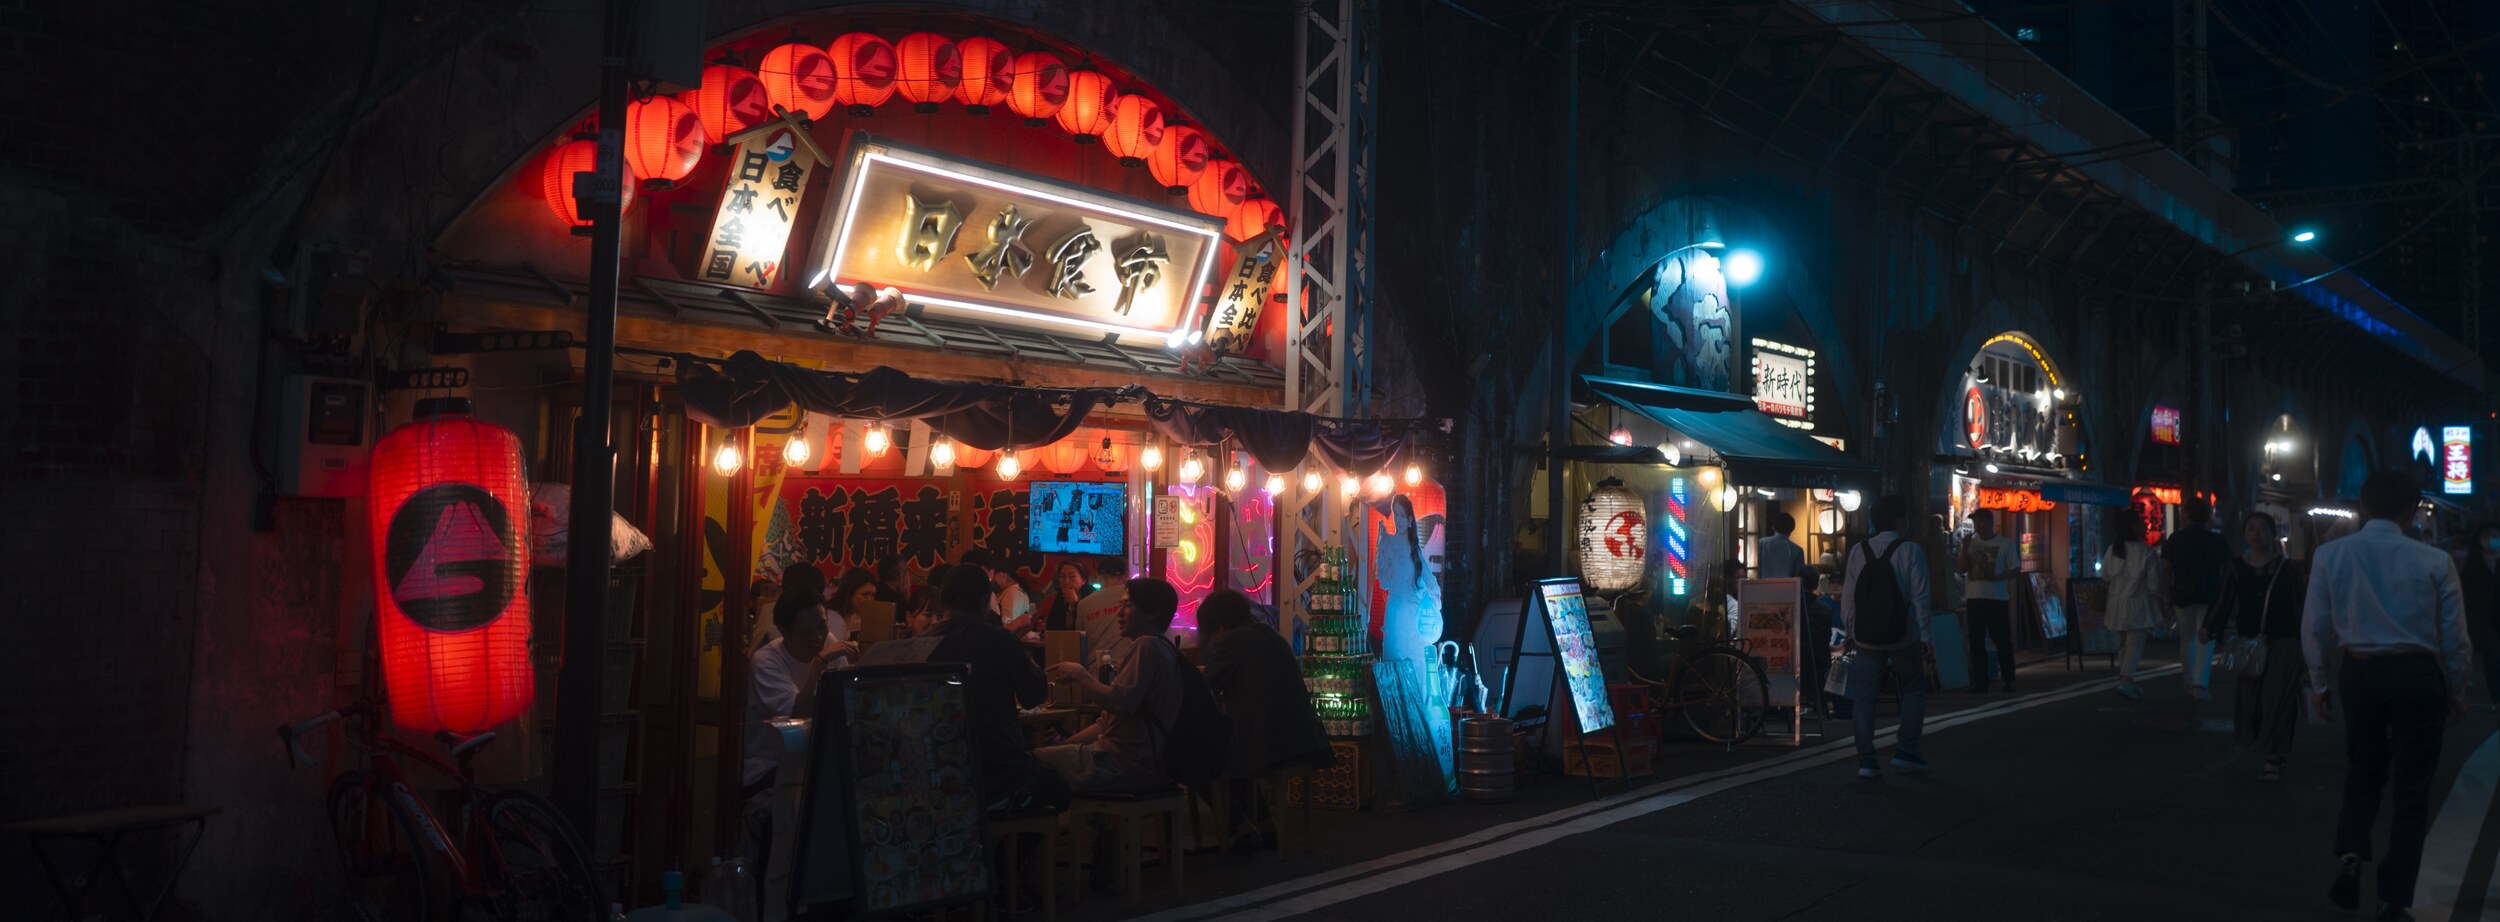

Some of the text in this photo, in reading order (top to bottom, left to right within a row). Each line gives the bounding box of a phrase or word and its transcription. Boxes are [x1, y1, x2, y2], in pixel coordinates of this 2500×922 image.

[706, 149, 769, 280] 日本全国
[896, 190, 1171, 315] 日本食市
[1213, 256, 1257, 340] 日本全
[1762, 364, 1802, 402] 新時代
[2447, 444, 2468, 479] 王将
